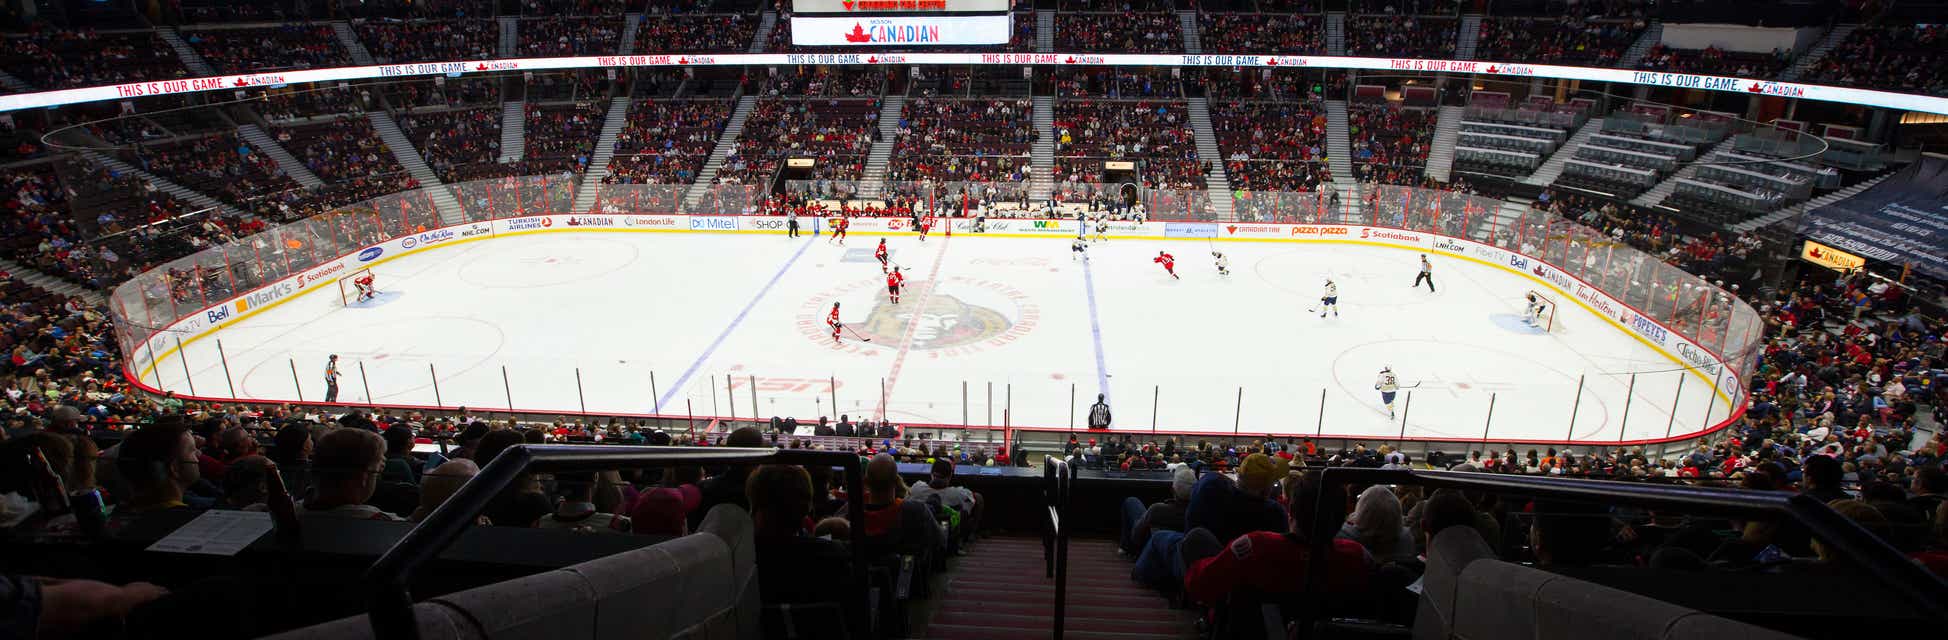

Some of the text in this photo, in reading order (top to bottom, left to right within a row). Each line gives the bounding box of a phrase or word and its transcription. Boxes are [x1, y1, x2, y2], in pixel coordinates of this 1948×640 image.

[870, 25, 939, 42] CANADIAN
[598, 56, 616, 66] THIS
[618, 56, 627, 66] IS
[629, 56, 646, 65] OUR
[687, 57, 715, 65] CANADIAN
[787, 55, 805, 64] THIS
[807, 55, 816, 64] IS
[818, 55, 835, 64] OUR
[877, 56, 906, 64] CANADIAN
[982, 54, 1001, 64] THIS
[1003, 54, 1011, 64] IS
[1014, 54, 1032, 64] OUR
[1074, 56, 1104, 64] CANADIAN
[1182, 56, 1201, 65] THIS
[1204, 56, 1212, 65] IS
[1215, 56, 1233, 65] OUR
[1277, 57, 1307, 66] CANADIAN
[379, 65, 402, 77] THIS
[405, 65, 415, 75] IS
[418, 63, 439, 74] OUR
[1391, 59, 1411, 70] THIS
[1414, 60, 1423, 70] IS
[1427, 61, 1447, 71] OUR
[1499, 65, 1534, 75] CANADIAN
[247, 76, 285, 86] CANADIAN
[1633, 72, 1742, 91] THIS IS OUR GAME.
[116, 85, 143, 97] THIS
[149, 83, 160, 94] IS
[164, 81, 188, 93] OUR
[1762, 84, 1805, 97] CANADIAN
[579, 217, 614, 226] CANADIAN
[707, 218, 735, 229] Mitel
[757, 220, 782, 229] SHOP
[462, 228, 489, 237] NHL.COM
[1292, 227, 1347, 236] pizza pizza
[1373, 231, 1420, 242] Scotiabank
[1435, 242, 1464, 252] LNH.COM
[1511, 255, 1528, 270] Bell
[1821, 252, 1857, 269] CANADIAN
[307, 263, 344, 282] Scotiabank
[1544, 269, 1572, 289] CANADIAN
[247, 282, 292, 309] Mark's
[1576, 284, 1617, 317] Tim Hortons
[207, 305, 229, 323] Bell
[1633, 314, 1667, 341] POPEYE'S
